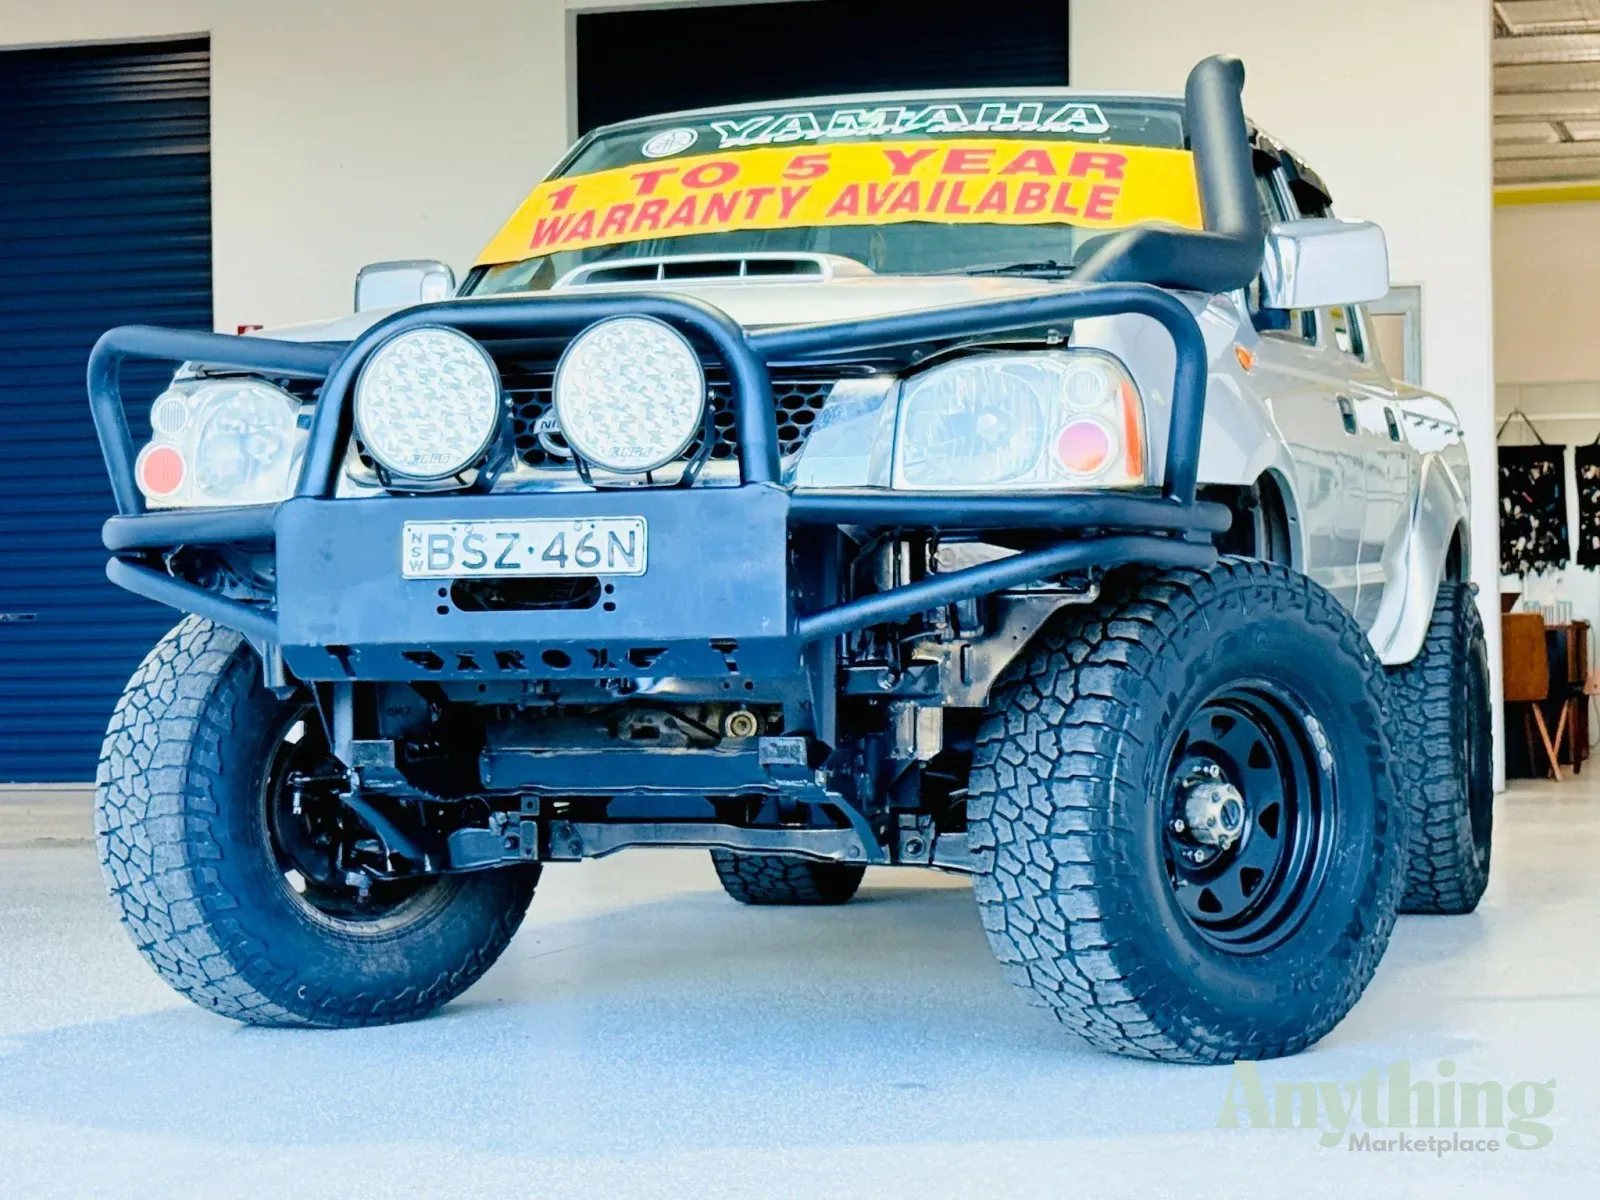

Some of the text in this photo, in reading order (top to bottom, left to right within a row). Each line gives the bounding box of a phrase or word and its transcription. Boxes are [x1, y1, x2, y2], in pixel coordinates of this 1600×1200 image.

[710, 102, 1110, 149] YAMAHA
[547, 148, 1128, 211] 1 TO 5 YEAR
[529, 180, 1121, 250] WARRANTY AVAILABLE
